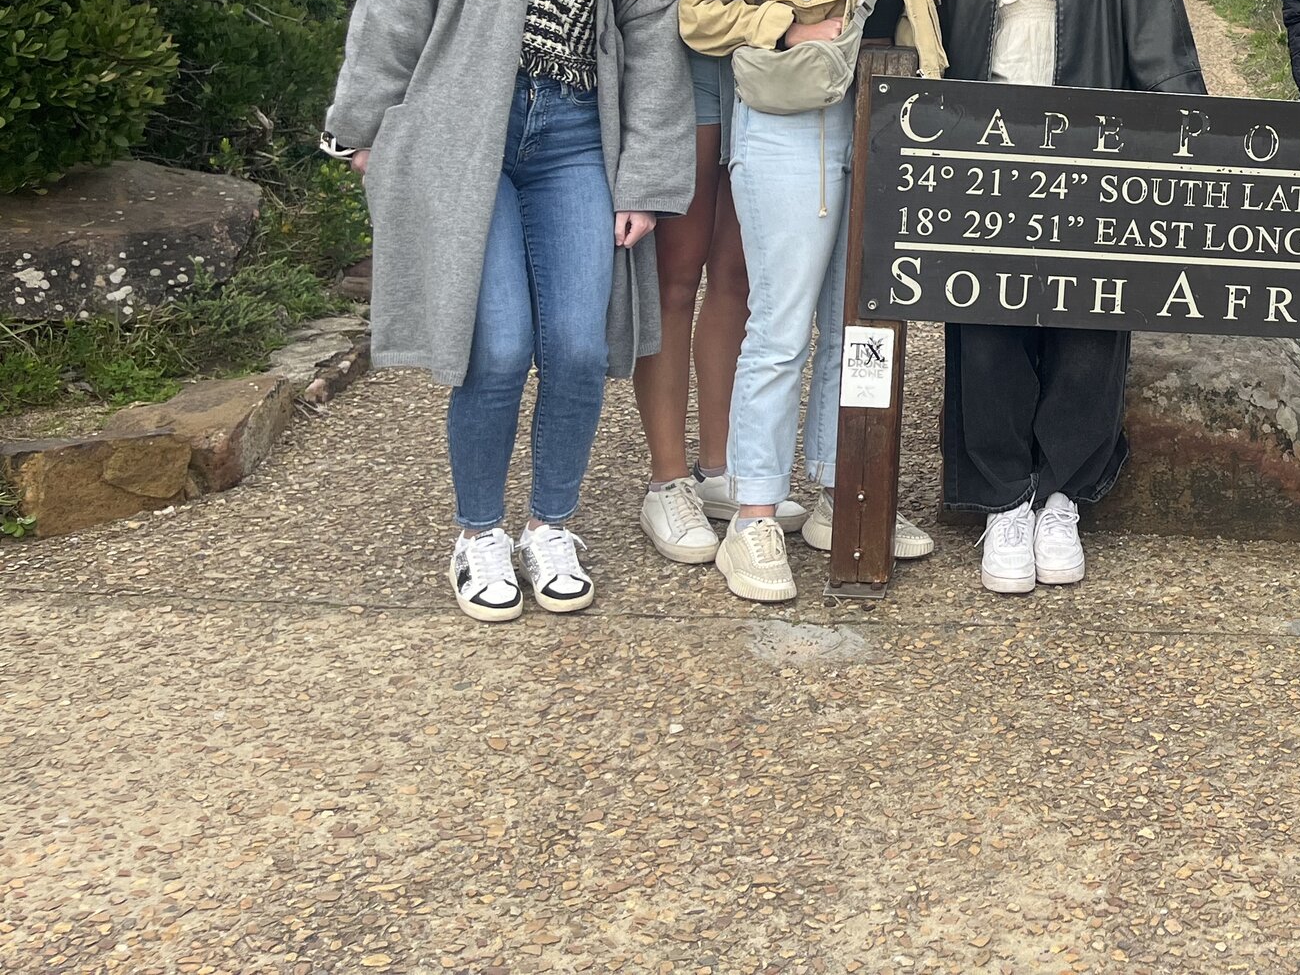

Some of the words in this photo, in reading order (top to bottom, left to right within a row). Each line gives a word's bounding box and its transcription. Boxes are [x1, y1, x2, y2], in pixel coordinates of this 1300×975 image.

[900, 92, 1125, 153] CAPE
[897, 163, 955, 193] 34°
[1099, 174, 1230, 208] SOUTH
[898, 206, 952, 236] 18°
[1093, 217, 1194, 249] EAST
[889, 256, 1129, 315] SOUTH
[851, 369, 884, 379] ZONE
